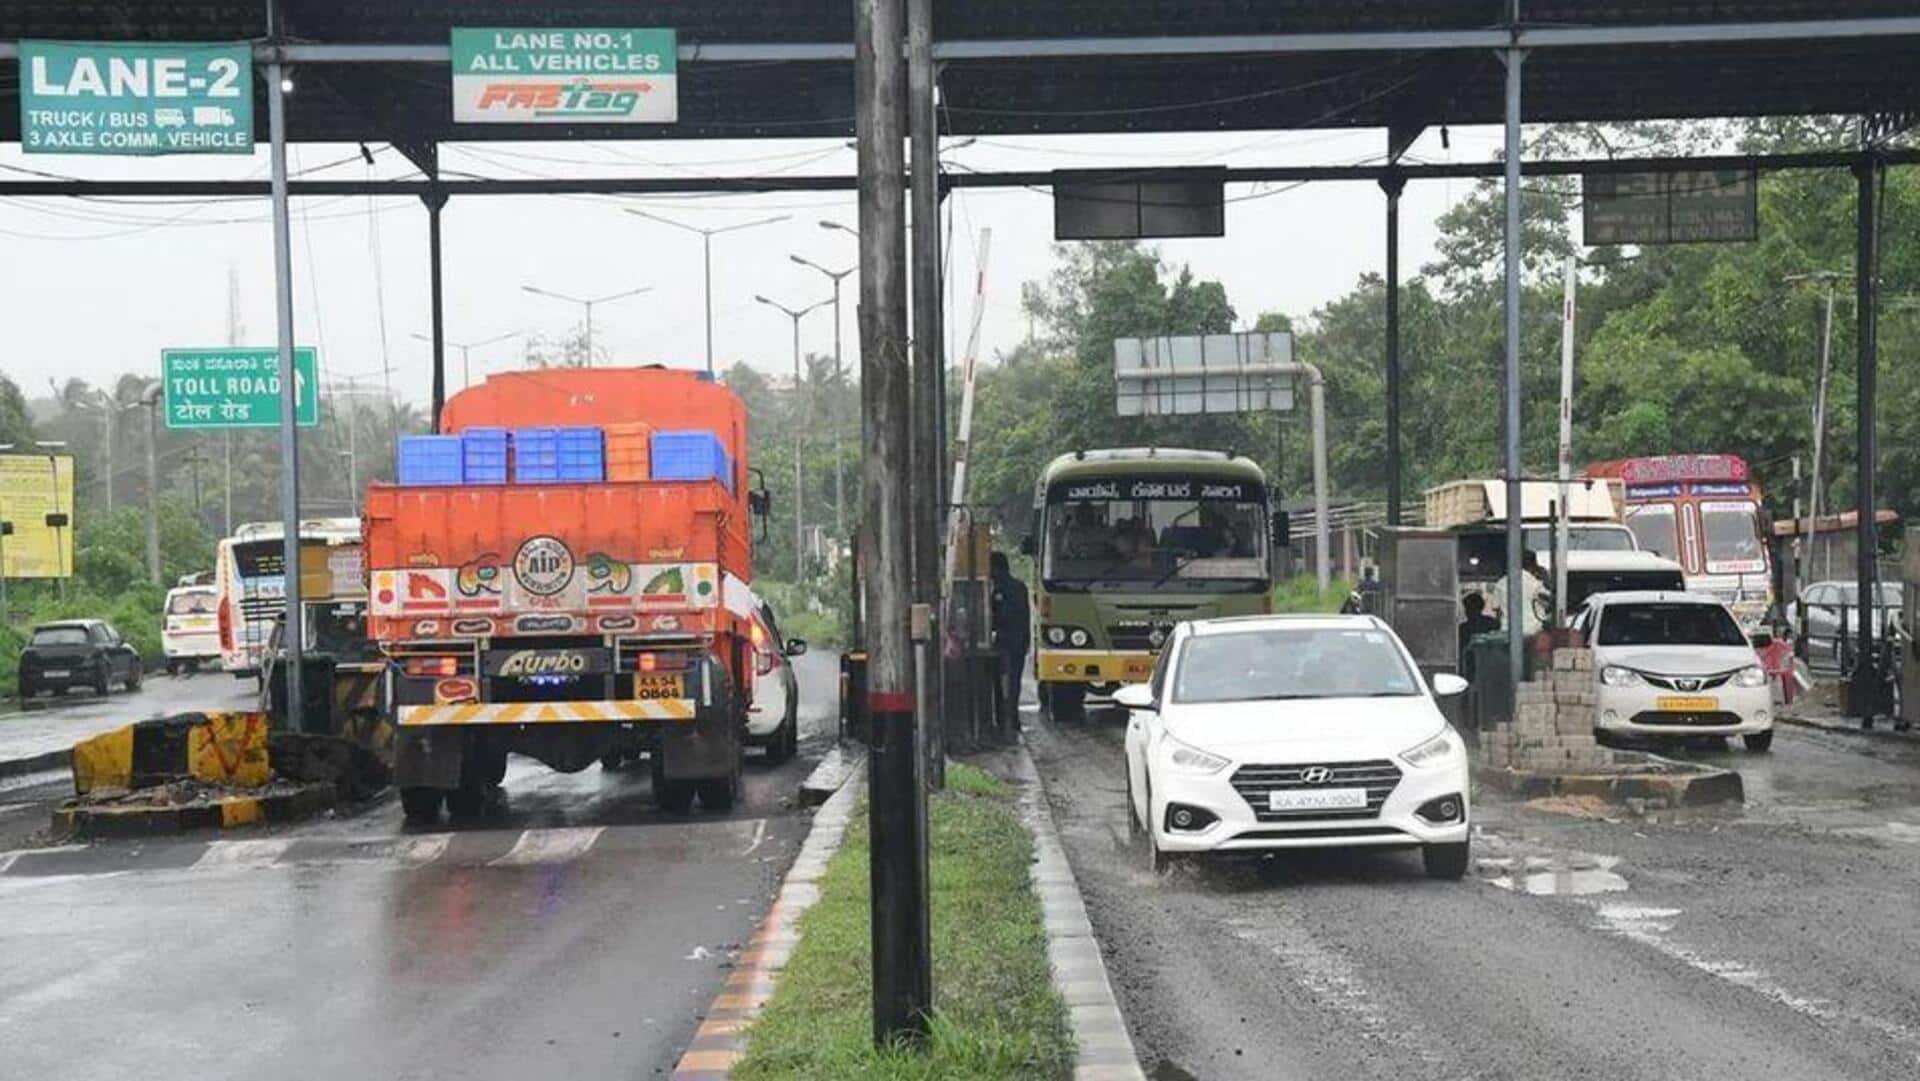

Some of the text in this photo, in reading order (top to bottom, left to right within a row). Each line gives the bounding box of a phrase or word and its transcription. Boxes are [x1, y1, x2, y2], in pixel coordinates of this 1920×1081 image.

[495, 33, 633, 49] LANE NO.1
[470, 53, 661, 70] ALL VEHICLES
[31, 55, 241, 97] LANE-2
[28, 109, 149, 127] TRUCK / BUS
[29, 131, 248, 147] 3 AXLE COMM. VEHICLE
[172, 378, 281, 395] TOLL ROAD
[174, 399, 252, 420] टोल रोड
